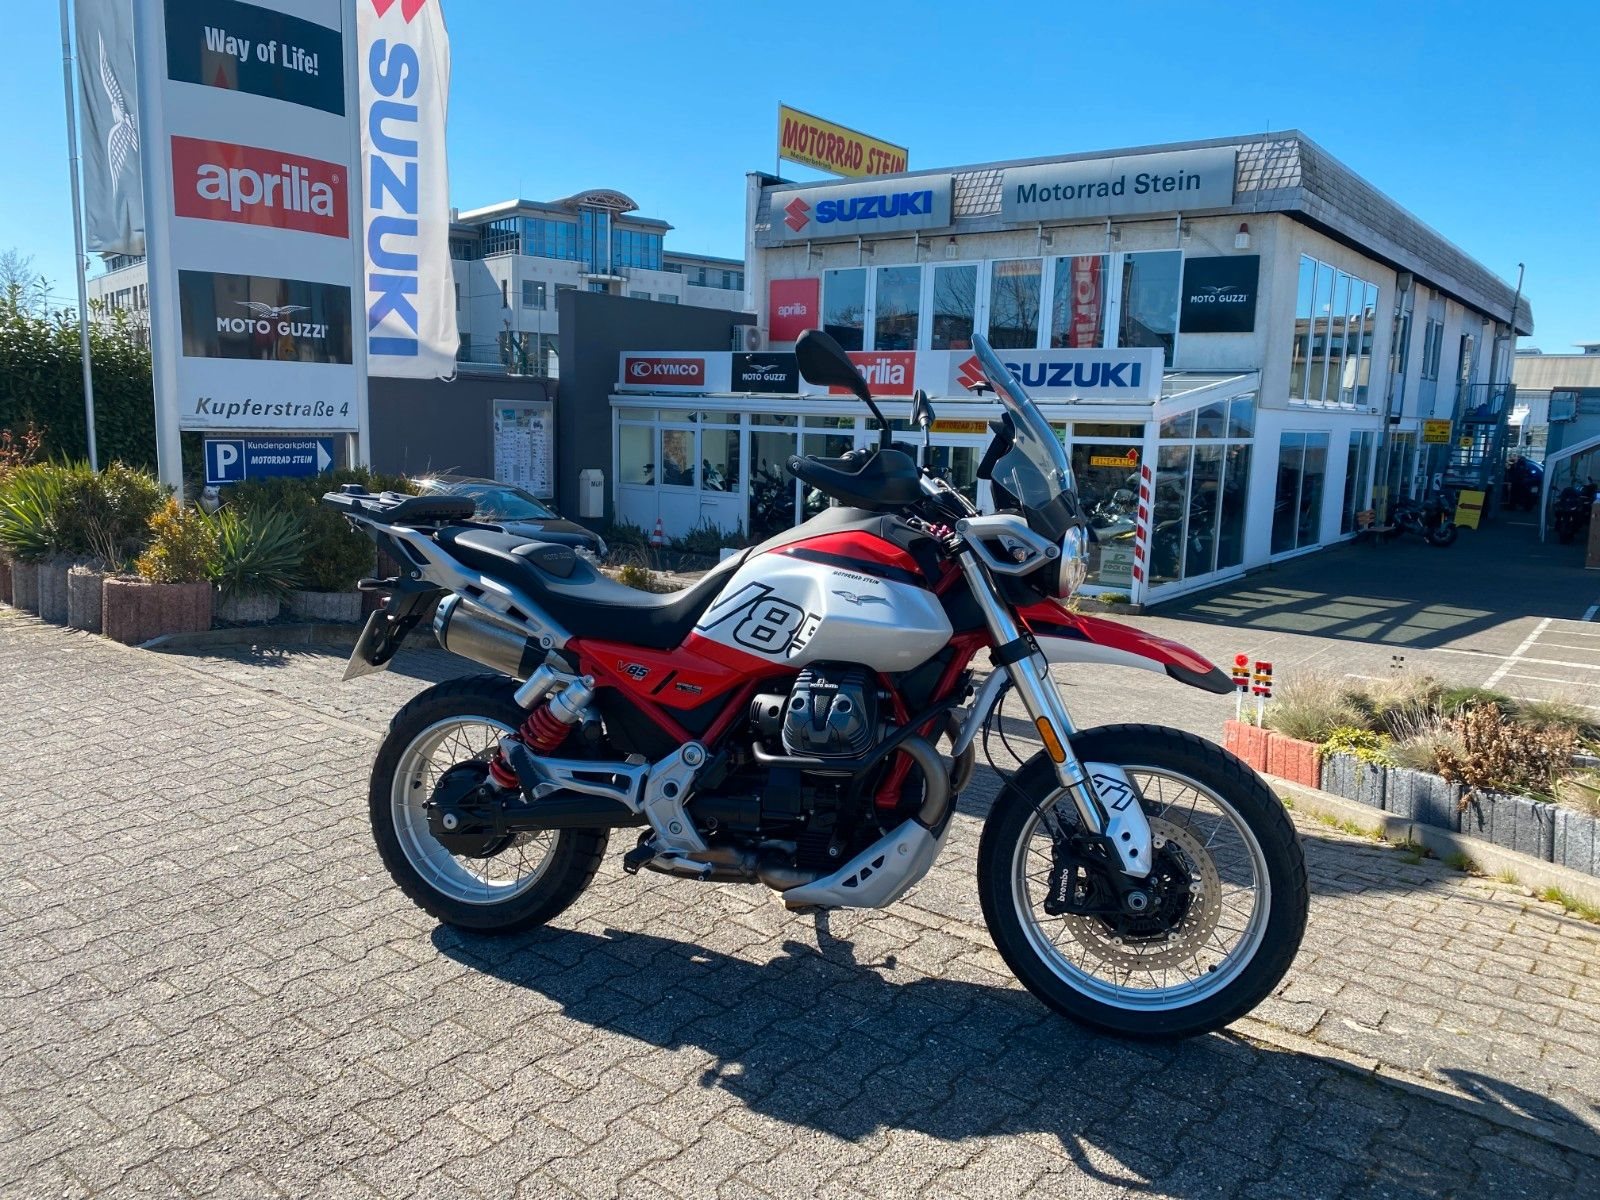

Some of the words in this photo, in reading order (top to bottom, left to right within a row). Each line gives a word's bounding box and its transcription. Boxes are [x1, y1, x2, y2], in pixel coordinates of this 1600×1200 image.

[204, 26, 250, 62] Way
[256, 40, 277, 65] of
[282, 44, 319, 76] Life!
[782, 117, 864, 170] MOTORRAD
[866, 147, 905, 175] STEIN
[196, 163, 334, 216] aprilia
[368, 38, 419, 357] SUZUKI
[1016, 175, 1126, 204] Motorrad
[1135, 170, 1202, 193] Stein
[815, 190, 933, 224] SUZUKI
[1190, 295, 1216, 303] MOTO
[1218, 294, 1247, 303] GUZZI
[778, 303, 807, 318] aprilia
[216, 317, 271, 335] MOTO
[277, 321, 326, 339] GUZZI
[653, 364, 699, 376] KYMCO
[742, 373, 762, 381] MOTO
[763, 373, 786, 381] GUZZI
[195, 397, 334, 418] Kupferstraße
[339, 402, 349, 417] 4
[216, 443, 238, 479] P
[247, 441, 317, 450] Kundenparkplatz
[250, 455, 291, 465] MOTORRAD
[292, 455, 313, 464] STEIN
[1092, 457, 1136, 466] EINGANG
[616, 660, 650, 677] V85
